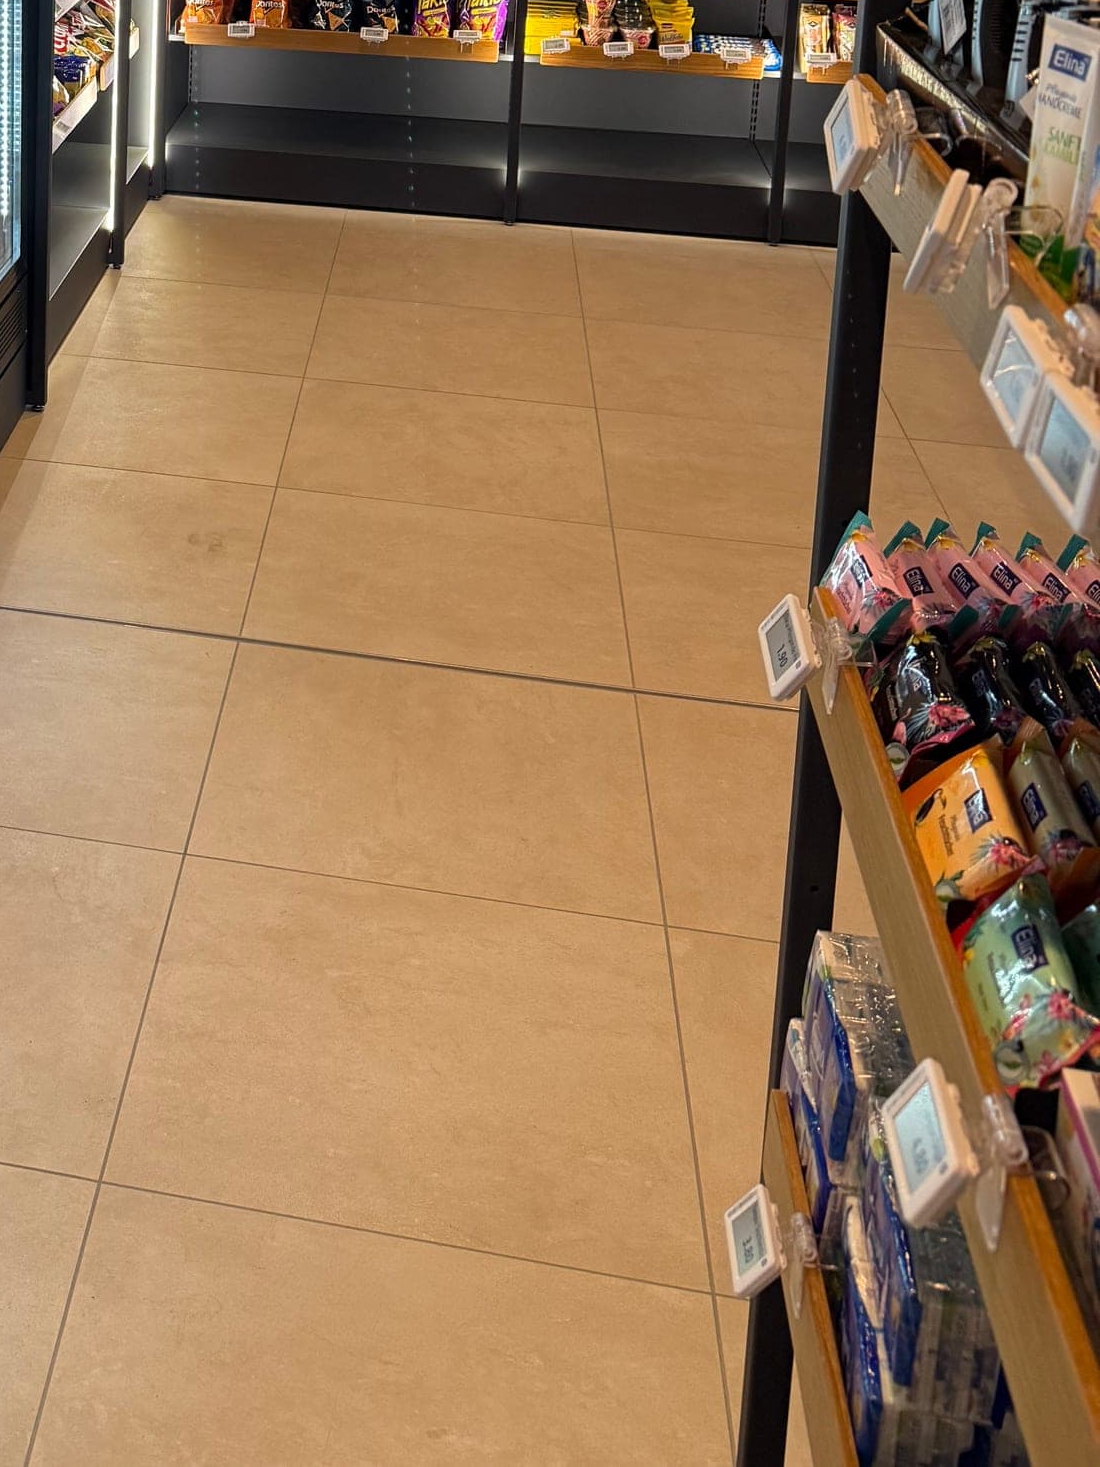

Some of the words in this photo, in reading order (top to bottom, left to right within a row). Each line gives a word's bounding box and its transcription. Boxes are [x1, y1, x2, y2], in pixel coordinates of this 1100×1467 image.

[256, 0, 284, 9] Doritos
[1054, 48, 1087, 76] Elina
[906, 568, 924, 592] Elina
[951, 565, 971, 592] Elina
[993, 565, 1014, 590] Elina
[1044, 576, 1064, 601] Elina
